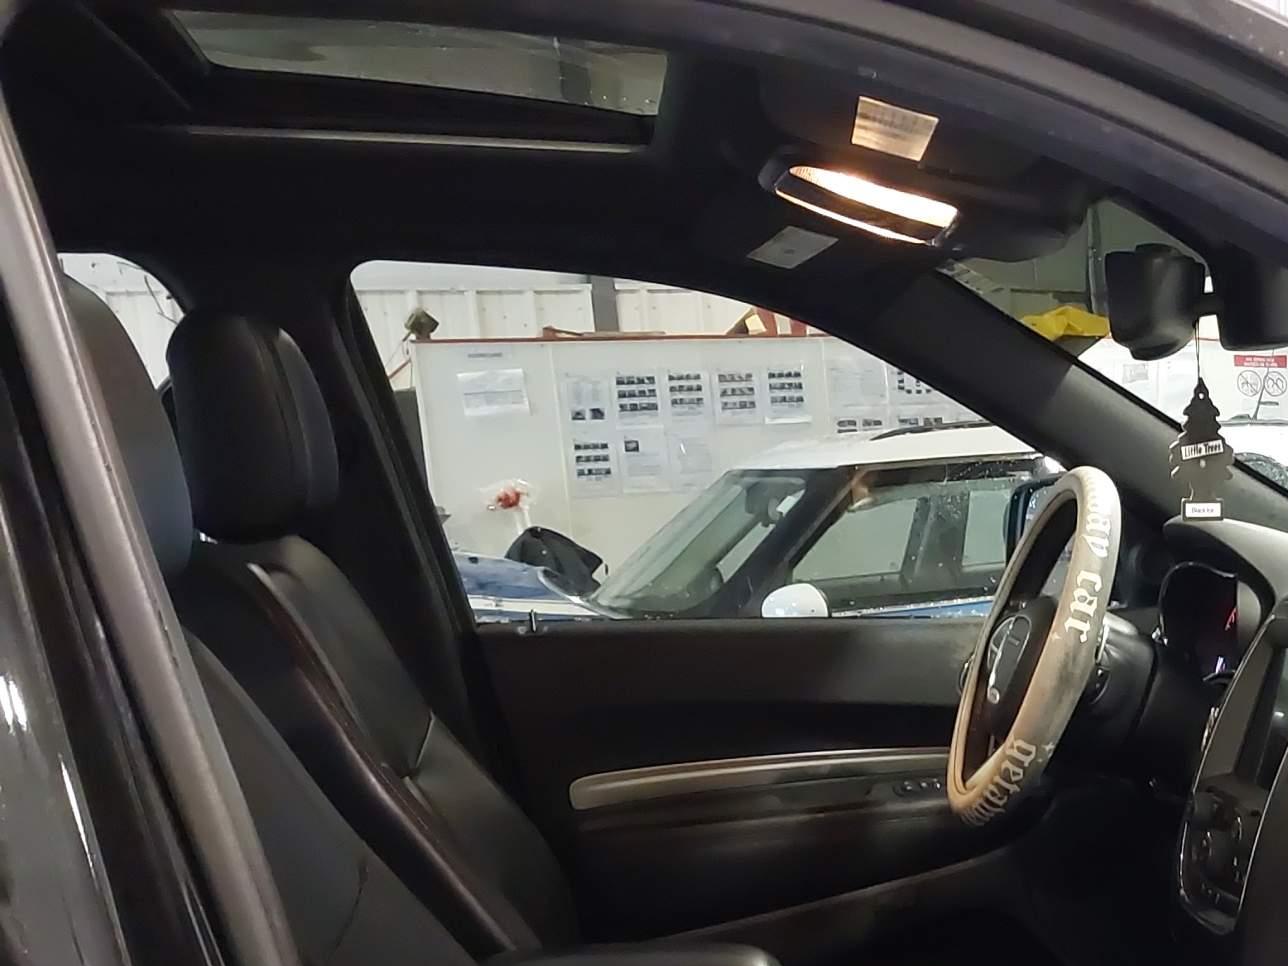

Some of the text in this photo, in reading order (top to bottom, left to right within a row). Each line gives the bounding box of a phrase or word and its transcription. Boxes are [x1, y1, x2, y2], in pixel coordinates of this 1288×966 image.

[1184, 441, 1221, 458] Little Trees
[1064, 570, 1102, 643] car
